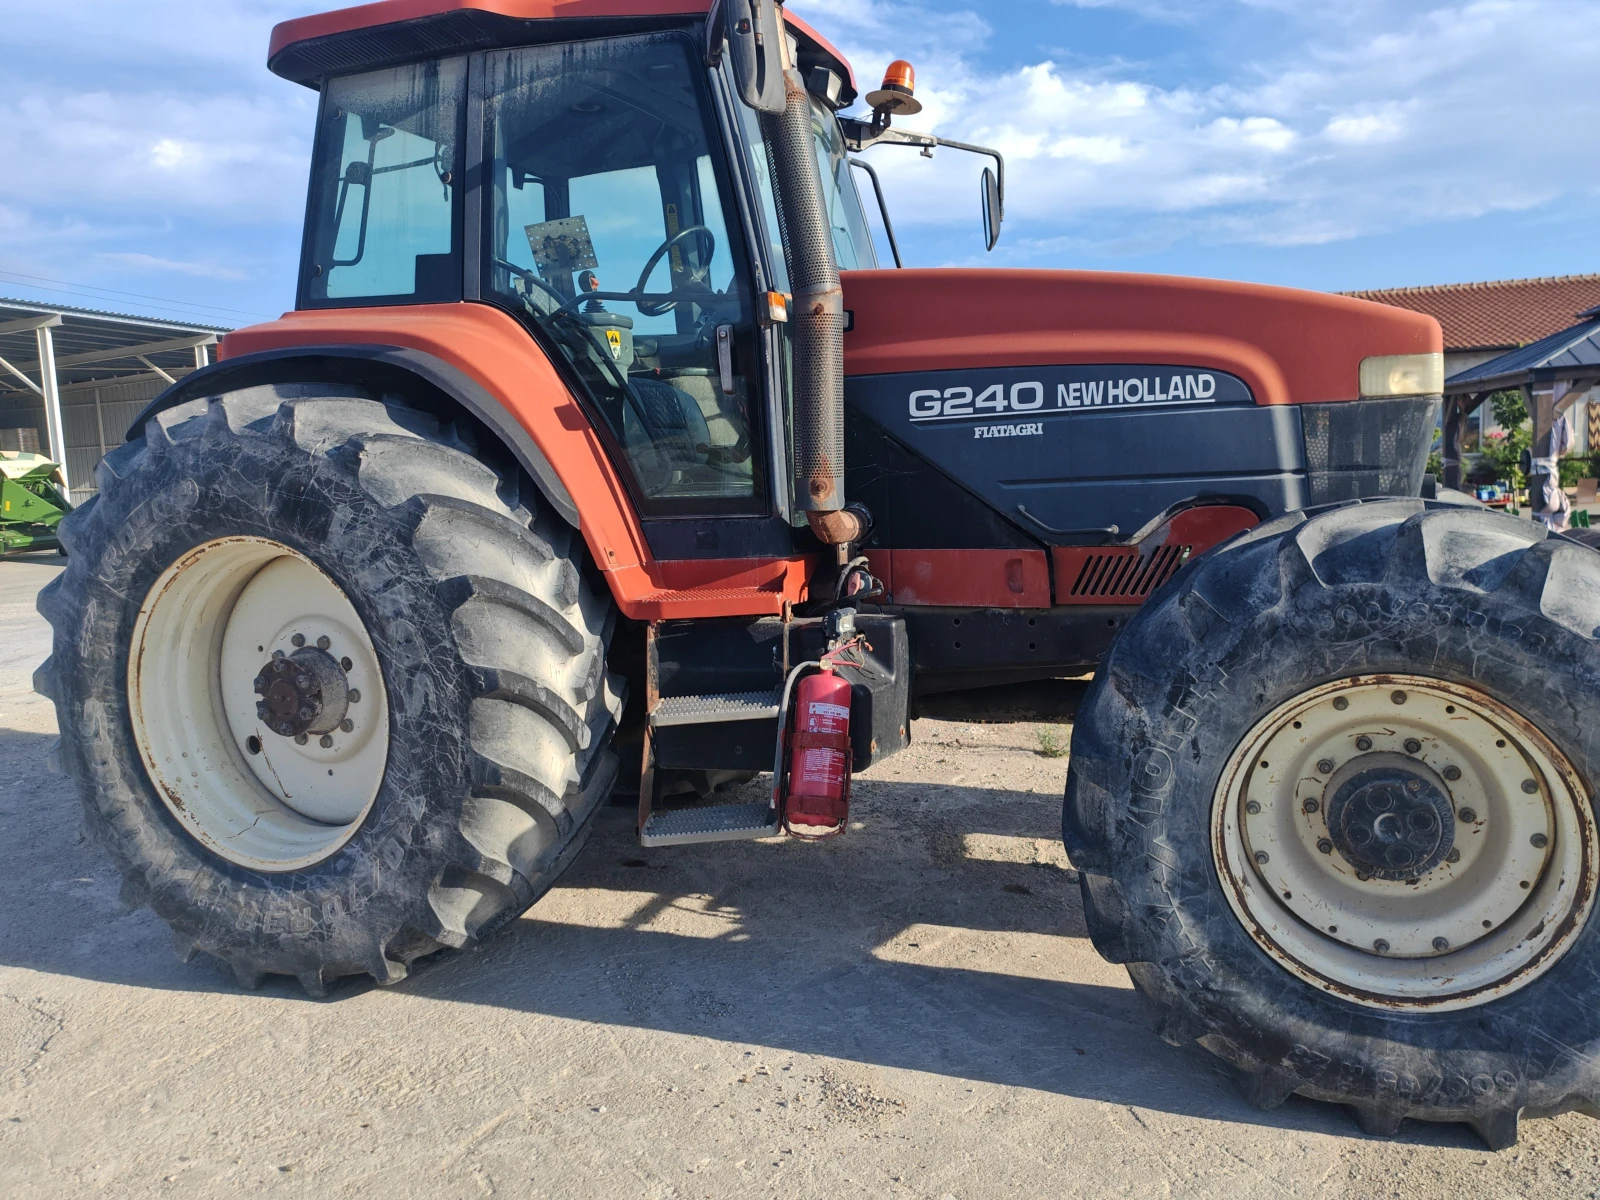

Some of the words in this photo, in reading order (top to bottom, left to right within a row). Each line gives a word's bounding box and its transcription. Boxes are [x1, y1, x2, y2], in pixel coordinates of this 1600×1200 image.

[908, 381, 1044, 418] G240
[1057, 380, 1104, 407] NEW
[1108, 373, 1216, 404] HOLLAND
[974, 423, 1043, 439] FIATAGRI
